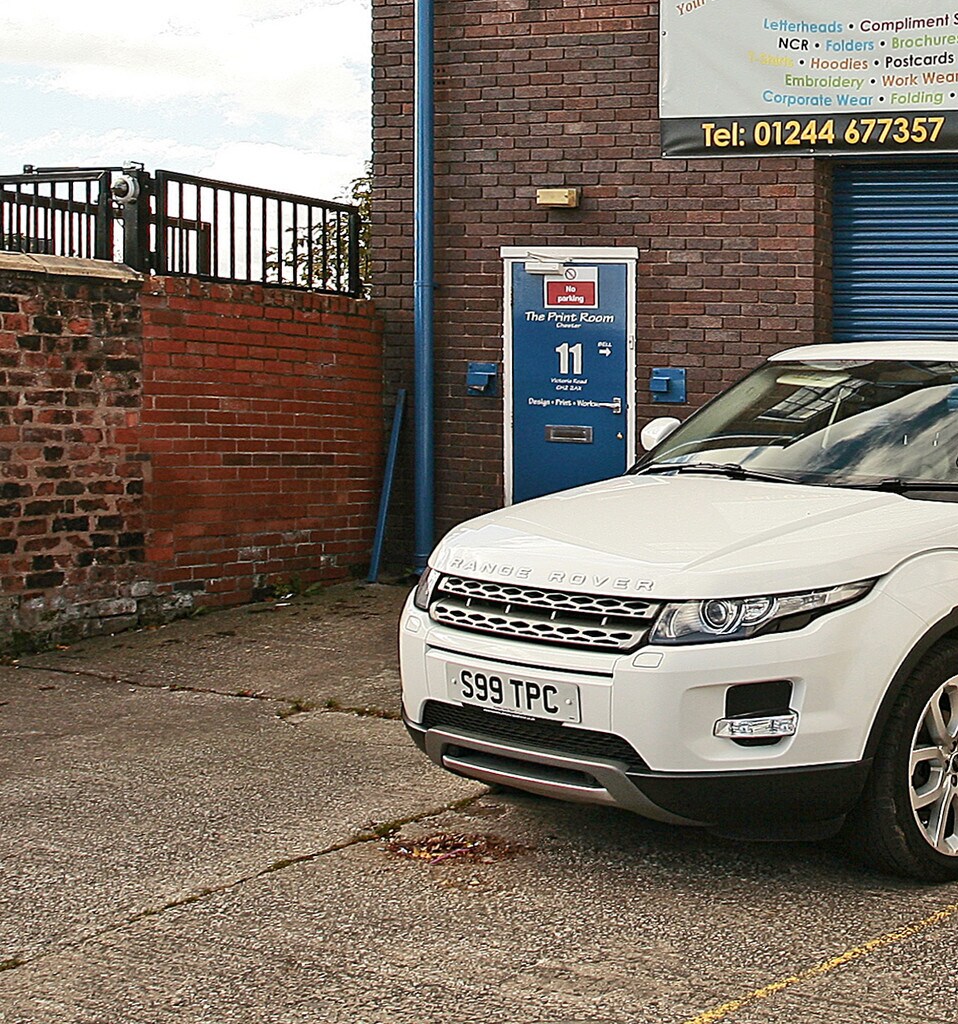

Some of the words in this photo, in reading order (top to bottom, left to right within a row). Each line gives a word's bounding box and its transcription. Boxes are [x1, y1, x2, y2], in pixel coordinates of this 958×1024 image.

[763, 18, 843, 33] Letterheads
[860, 14, 949, 33] Compliment
[778, 37, 809, 50] NCR
[825, 39, 874, 52] Folders
[811, 57, 868, 70] Hoodies
[885, 52, 954, 68] Postcards
[785, 73, 864, 90] Embroidery
[882, 74, 918, 87] Work
[762, 90, 832, 107] Corporate
[836, 94, 873, 106] Wear
[890, 90, 944, 105] Folding
[702, 122, 746, 147] Tel:
[753, 120, 835, 146] 01244
[844, 116, 945, 144] 677357
[565, 285, 577, 293] No
[557, 295, 585, 304] parking
[525, 311, 545, 322] The
[547, 311, 577, 322] Print
[580, 312, 614, 323] Room
[555, 342, 582, 375] 11
[528, 397, 551, 407] Design
[555, 398, 572, 406] Print
[449, 557, 533, 579] RANGE
[549, 570, 656, 592] ROVER
[460, 669, 504, 705] S99
[509, 679, 560, 714] TPC
